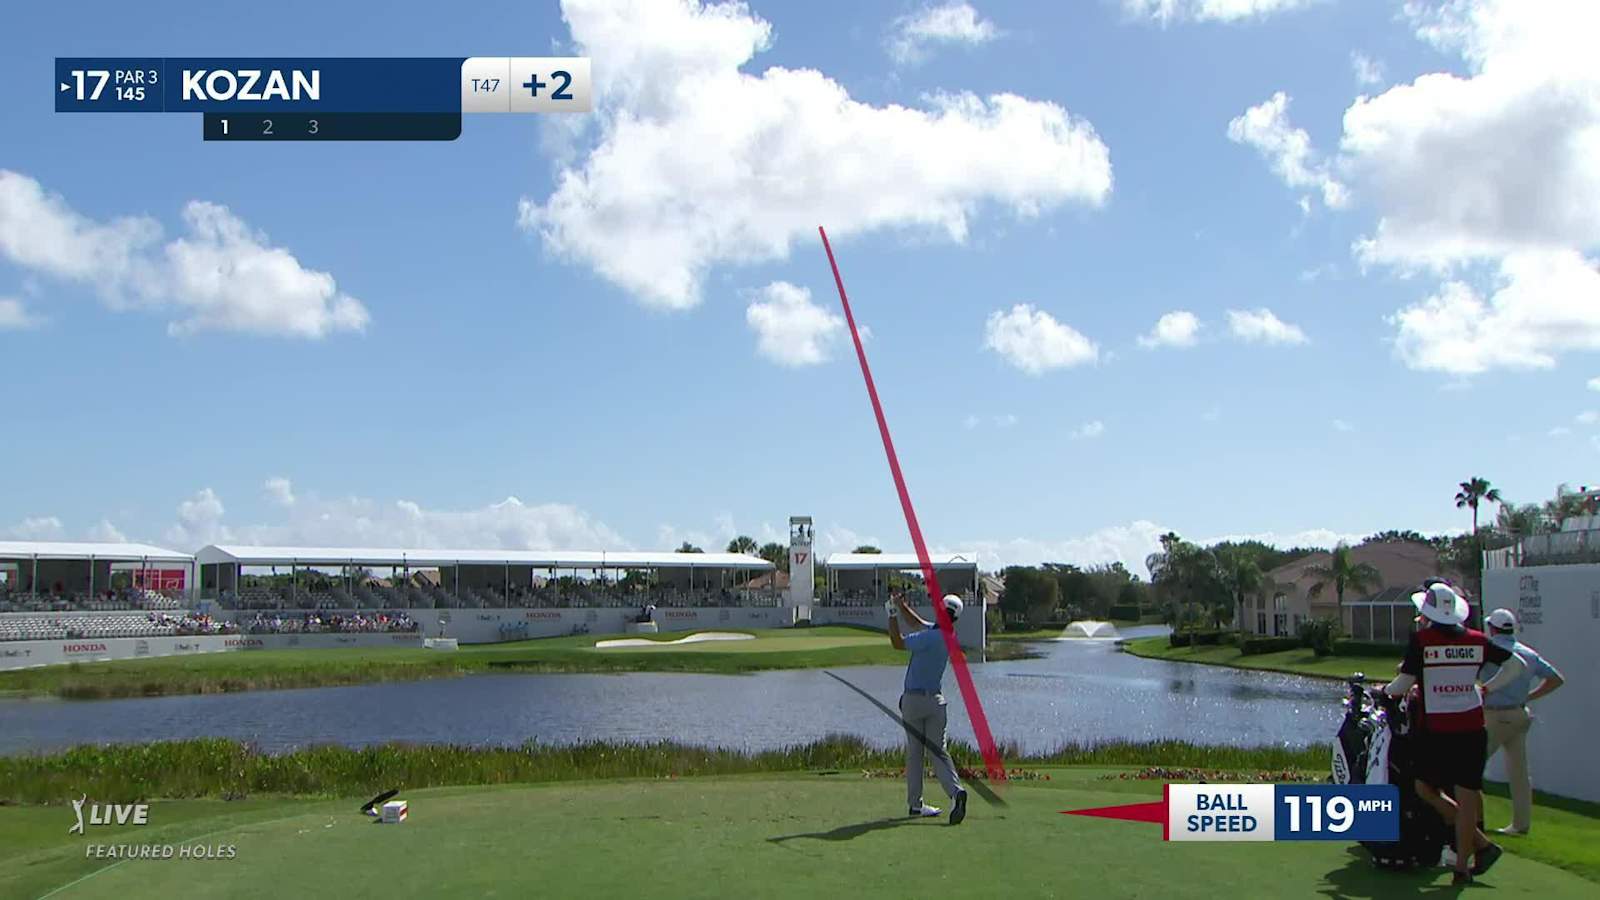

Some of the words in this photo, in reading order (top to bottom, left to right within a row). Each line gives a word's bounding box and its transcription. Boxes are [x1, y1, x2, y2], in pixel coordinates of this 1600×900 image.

[795, 552, 807, 564] 17
[63, 643, 107, 654] HONDA
[224, 638, 264, 648] HONDA
[1444, 647, 1475, 659] GLIGIC
